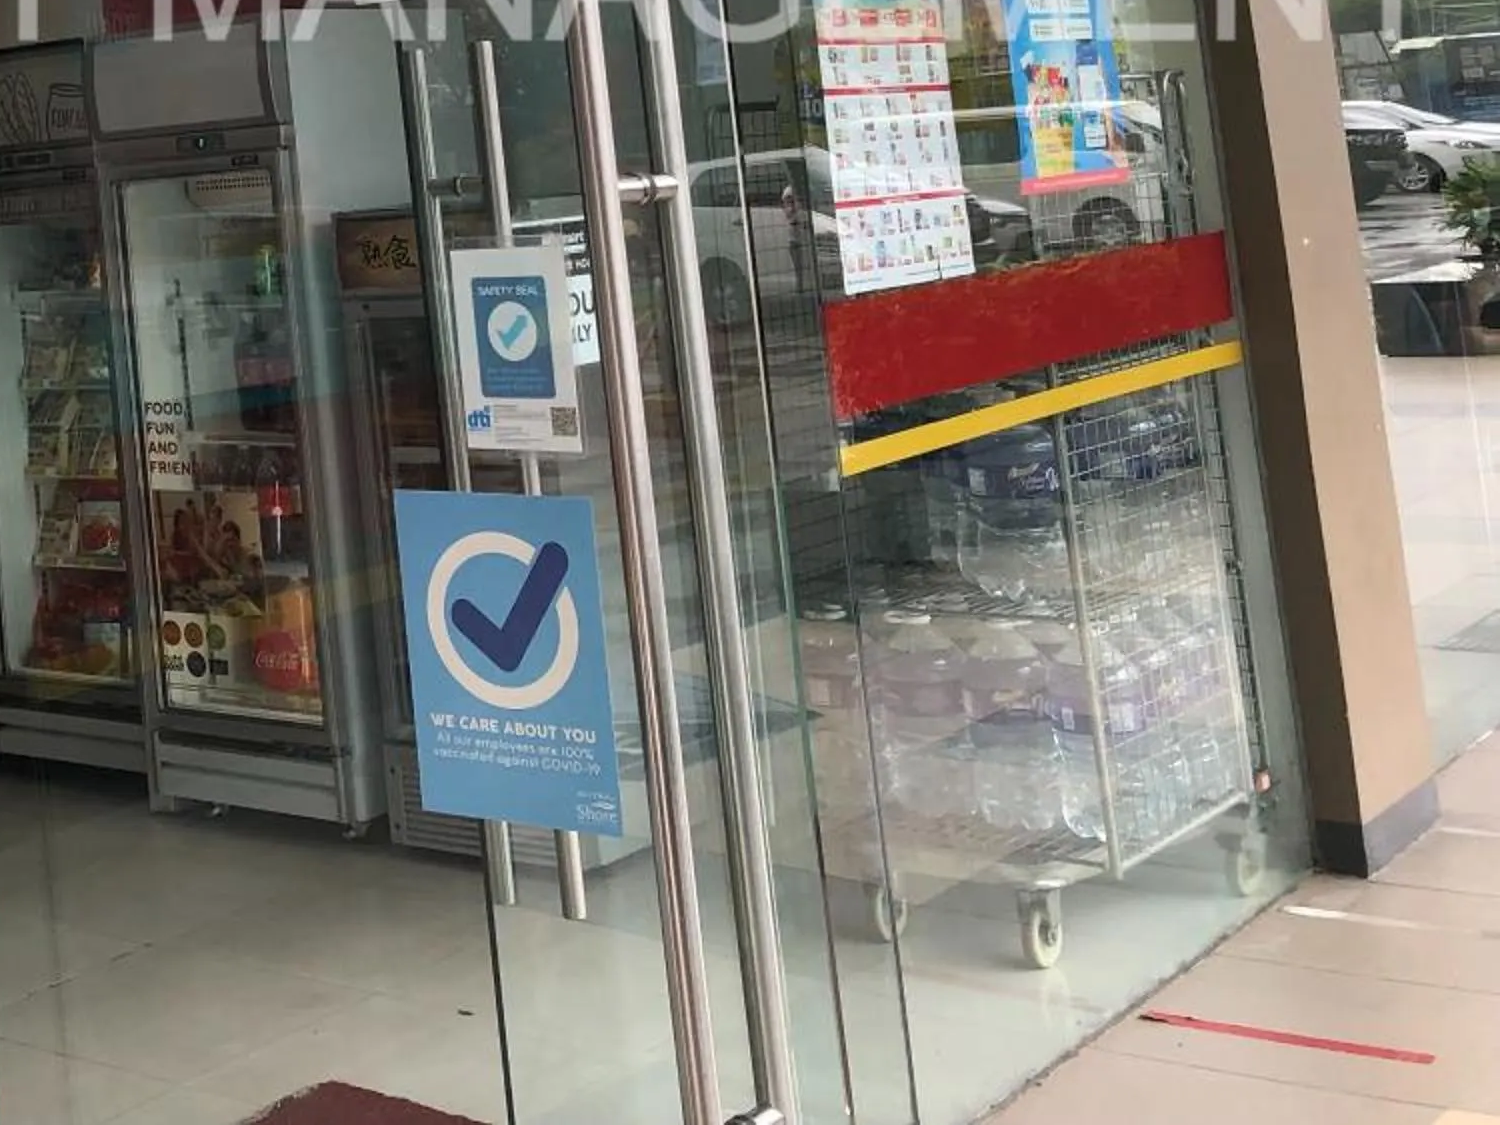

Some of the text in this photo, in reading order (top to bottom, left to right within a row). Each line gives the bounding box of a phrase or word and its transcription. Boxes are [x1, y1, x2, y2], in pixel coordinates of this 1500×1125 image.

[148, 441, 178, 455] AND
[430, 712, 597, 744] WE CARE ABOUT YOU
